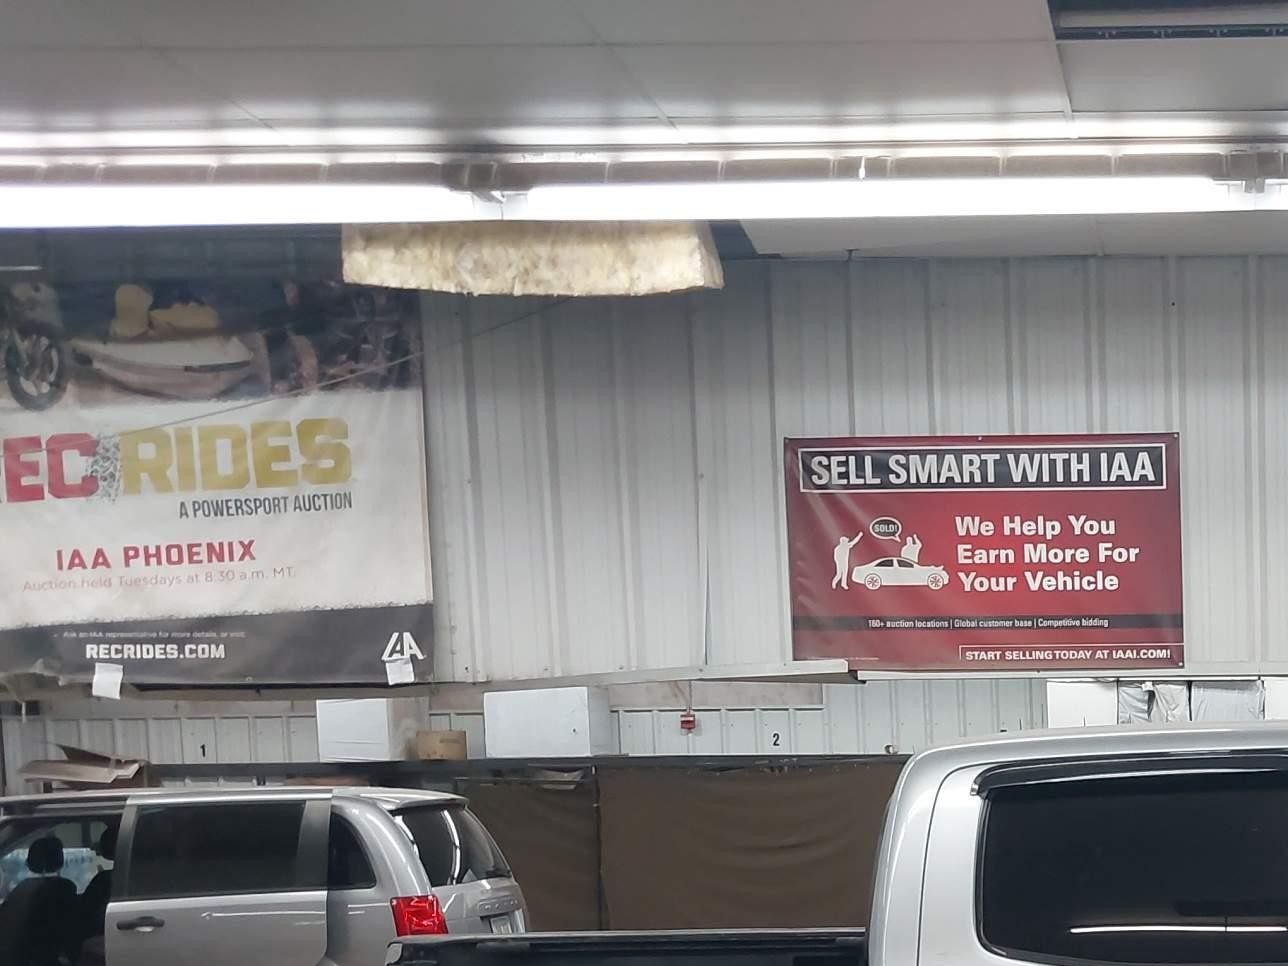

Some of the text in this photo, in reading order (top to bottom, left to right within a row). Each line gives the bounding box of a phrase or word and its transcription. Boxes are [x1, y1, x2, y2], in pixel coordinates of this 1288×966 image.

[0, 417, 352, 503] EC RIDES
[810, 451, 1156, 485] SELL SMART WITH IAA
[179, 492, 353, 519] A POWERSPORT AUCTION
[874, 524, 898, 533] SOLD!
[955, 515, 1116, 540] We Help You
[57, 539, 257, 571] IAA PHOENIX
[957, 542, 1140, 564] Earn More For
[23, 578, 77, 592] Auction
[81, 576, 112, 589] held
[119, 573, 182, 587] Tuesdays
[186, 572, 199, 584] at
[205, 569, 236, 583] 8:30
[957, 571, 1119, 592] Your Vehicle
[886, 618, 915, 628] auction
[915, 618, 949, 628] locations
[953, 618, 978, 628] Global
[979, 618, 1013, 628] customer
[1014, 618, 1033, 628] base
[1038, 617, 1081, 629] Competitive
[1082, 617, 1109, 628] bidding
[86, 643, 226, 659] RECRIDES.COM
[966, 649, 1171, 660] START SELLING TODAY AT IAAI.COM!
[772, 732, 781, 747] 2
[200, 743, 206, 758] 1
